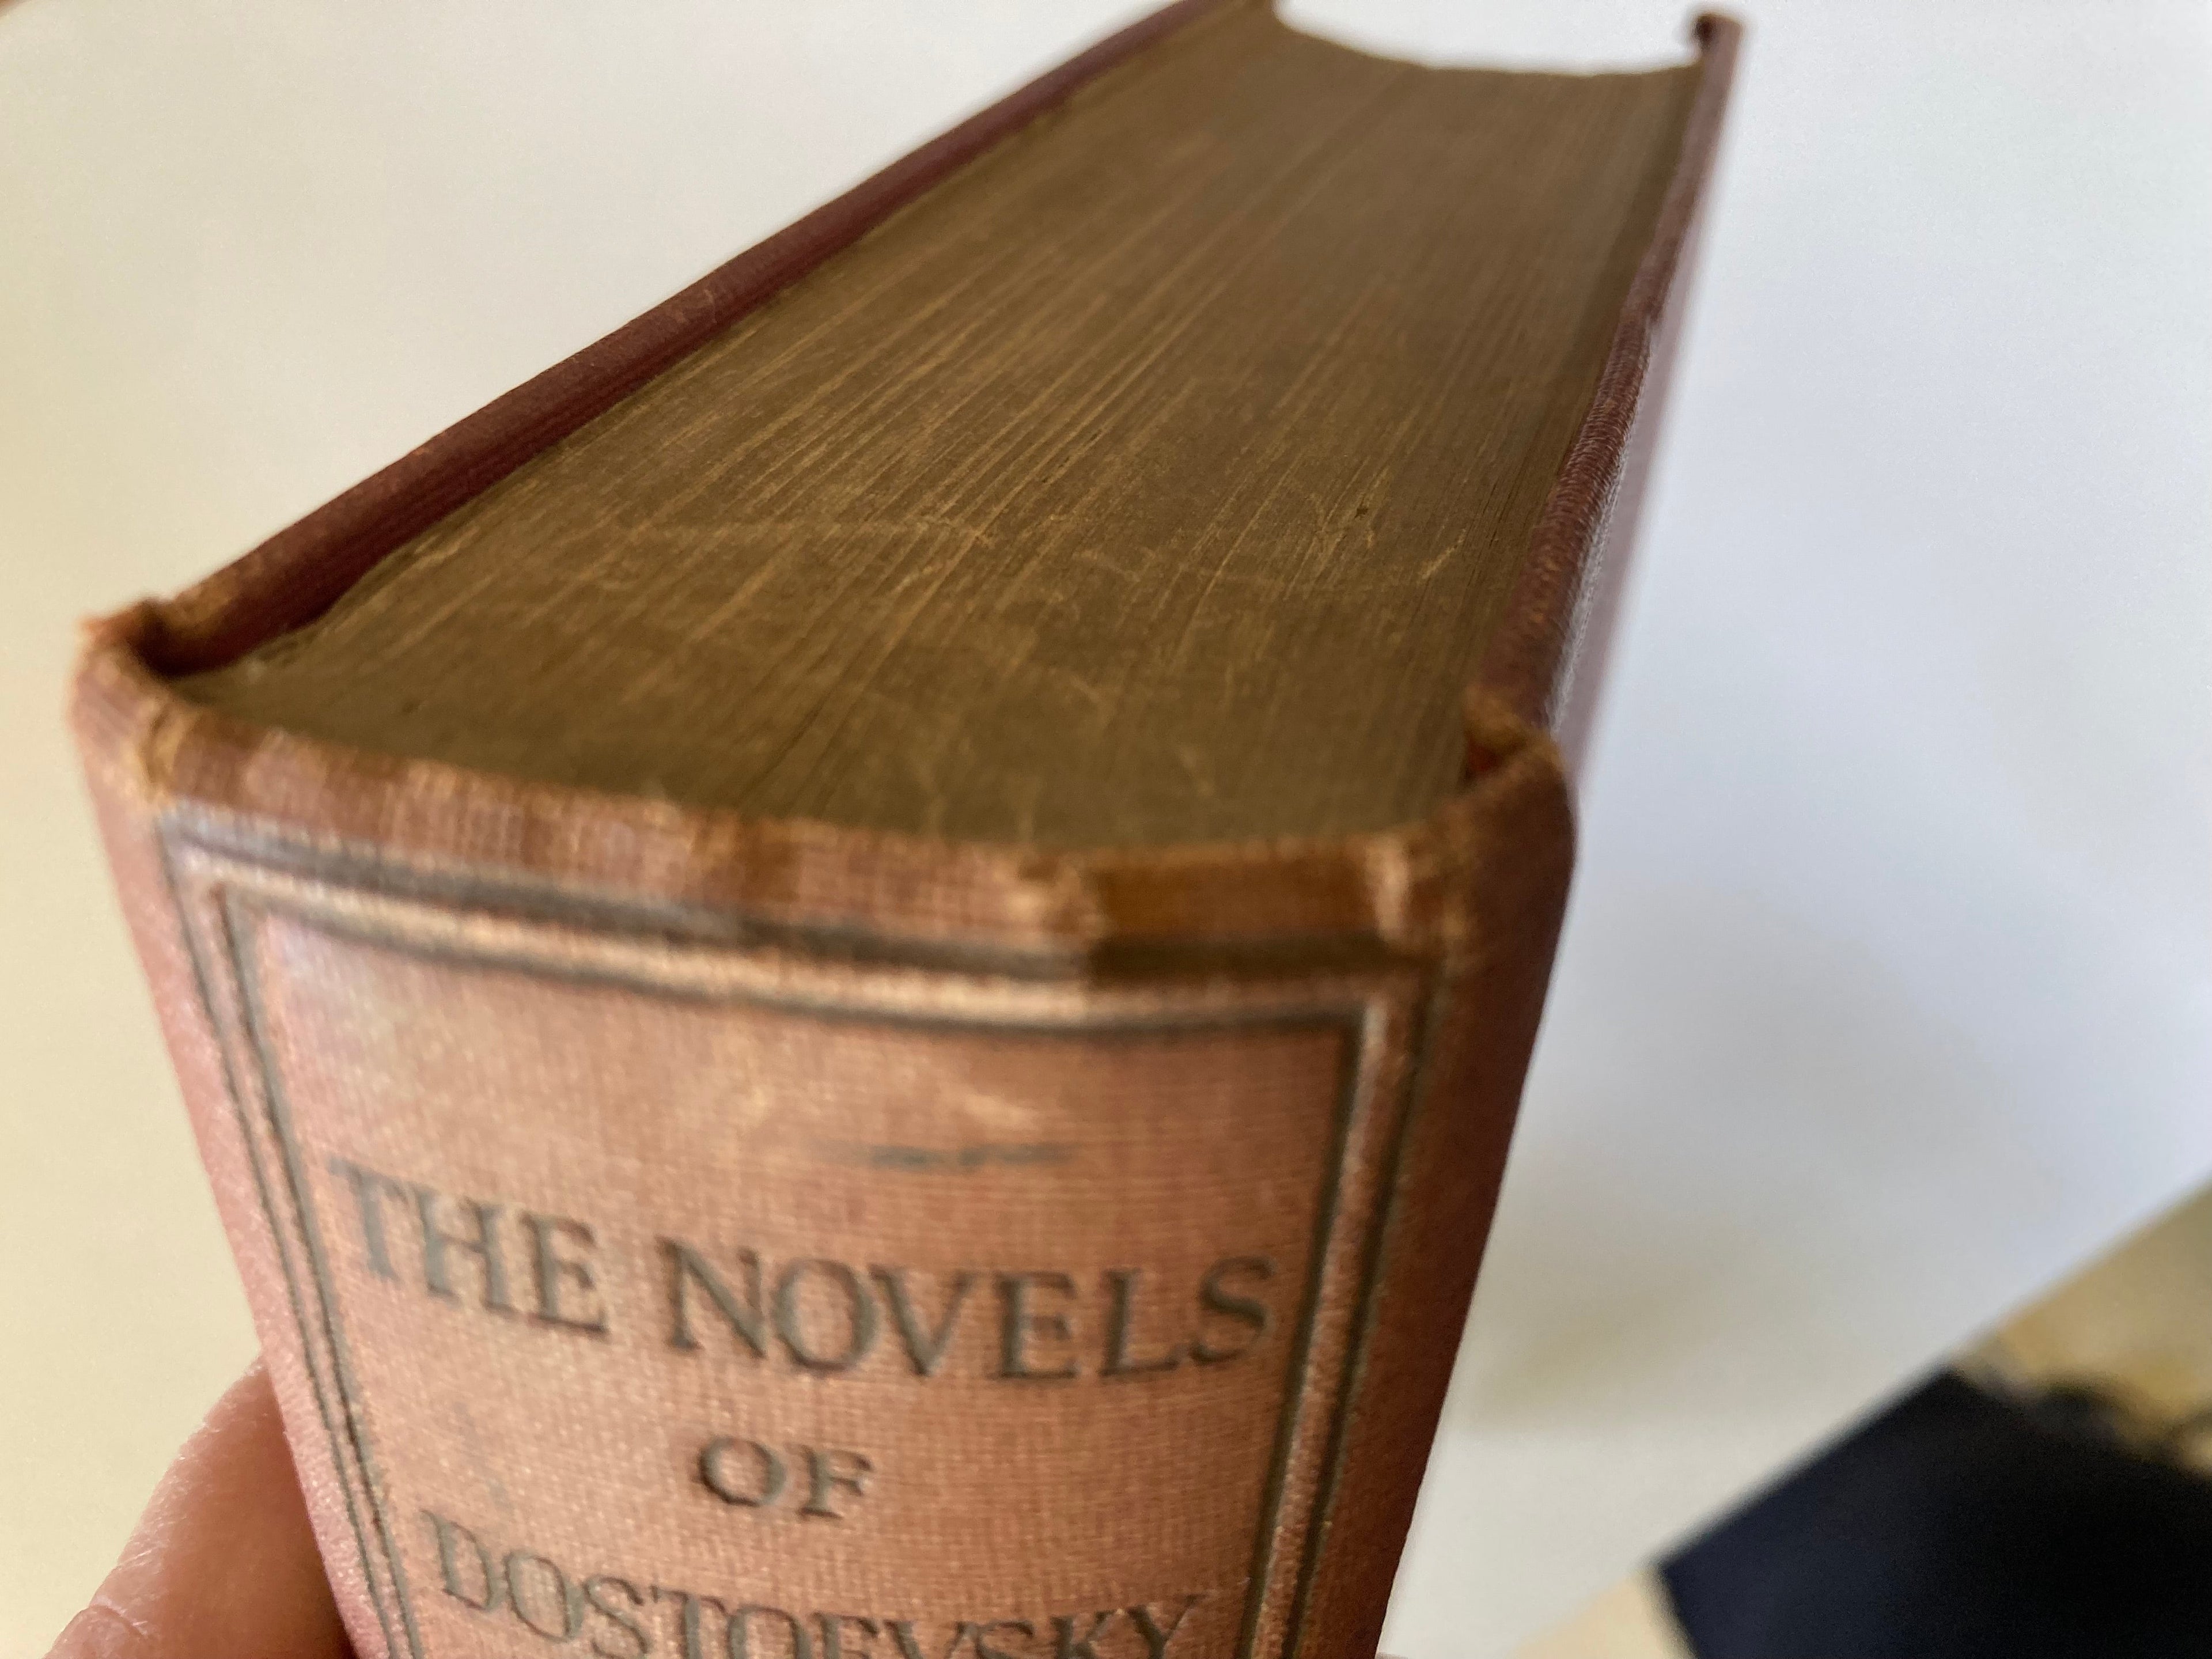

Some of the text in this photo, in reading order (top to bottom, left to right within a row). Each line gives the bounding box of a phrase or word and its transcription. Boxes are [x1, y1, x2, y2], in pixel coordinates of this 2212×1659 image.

[327, 1157, 1277, 1381] THE NOVELS
[698, 1435, 873, 1520] OF
